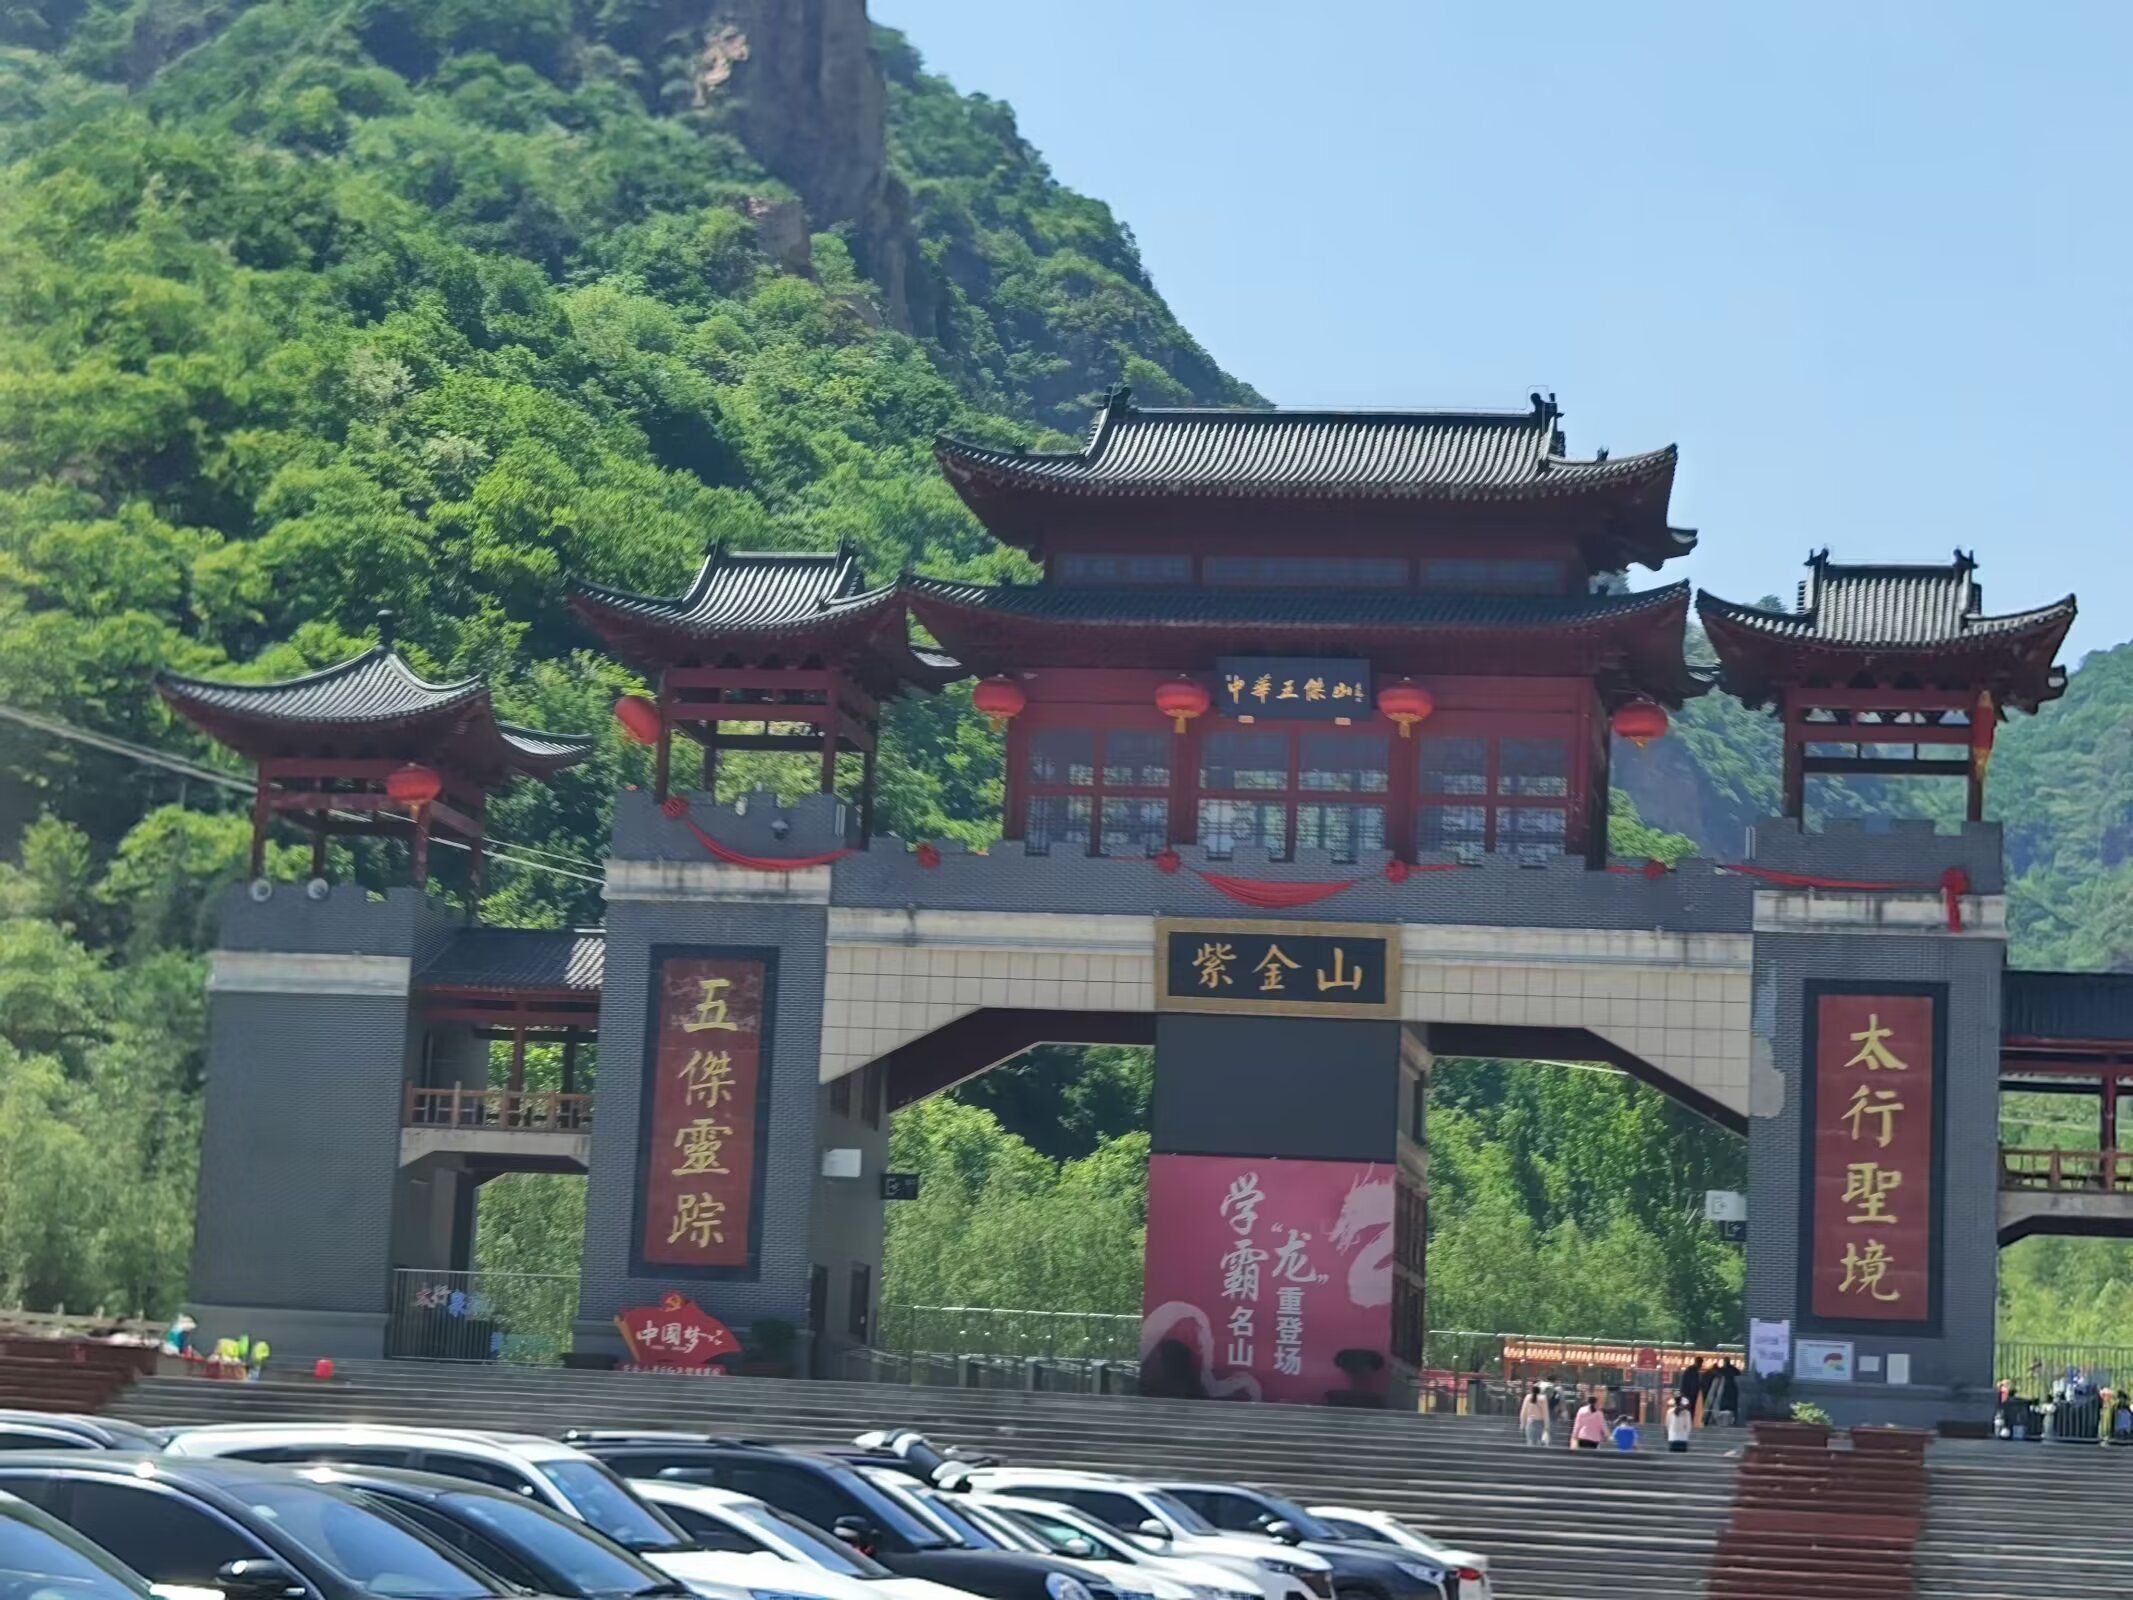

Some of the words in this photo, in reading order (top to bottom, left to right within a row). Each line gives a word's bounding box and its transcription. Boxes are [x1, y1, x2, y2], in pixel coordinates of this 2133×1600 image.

[1192, 942, 1363, 992] 紫金山
[1837, 1013, 1909, 1302] 太行聖境
[1220, 1171, 1269, 1368] 学霸名山
[636, 1320, 706, 1354] 中国梦
